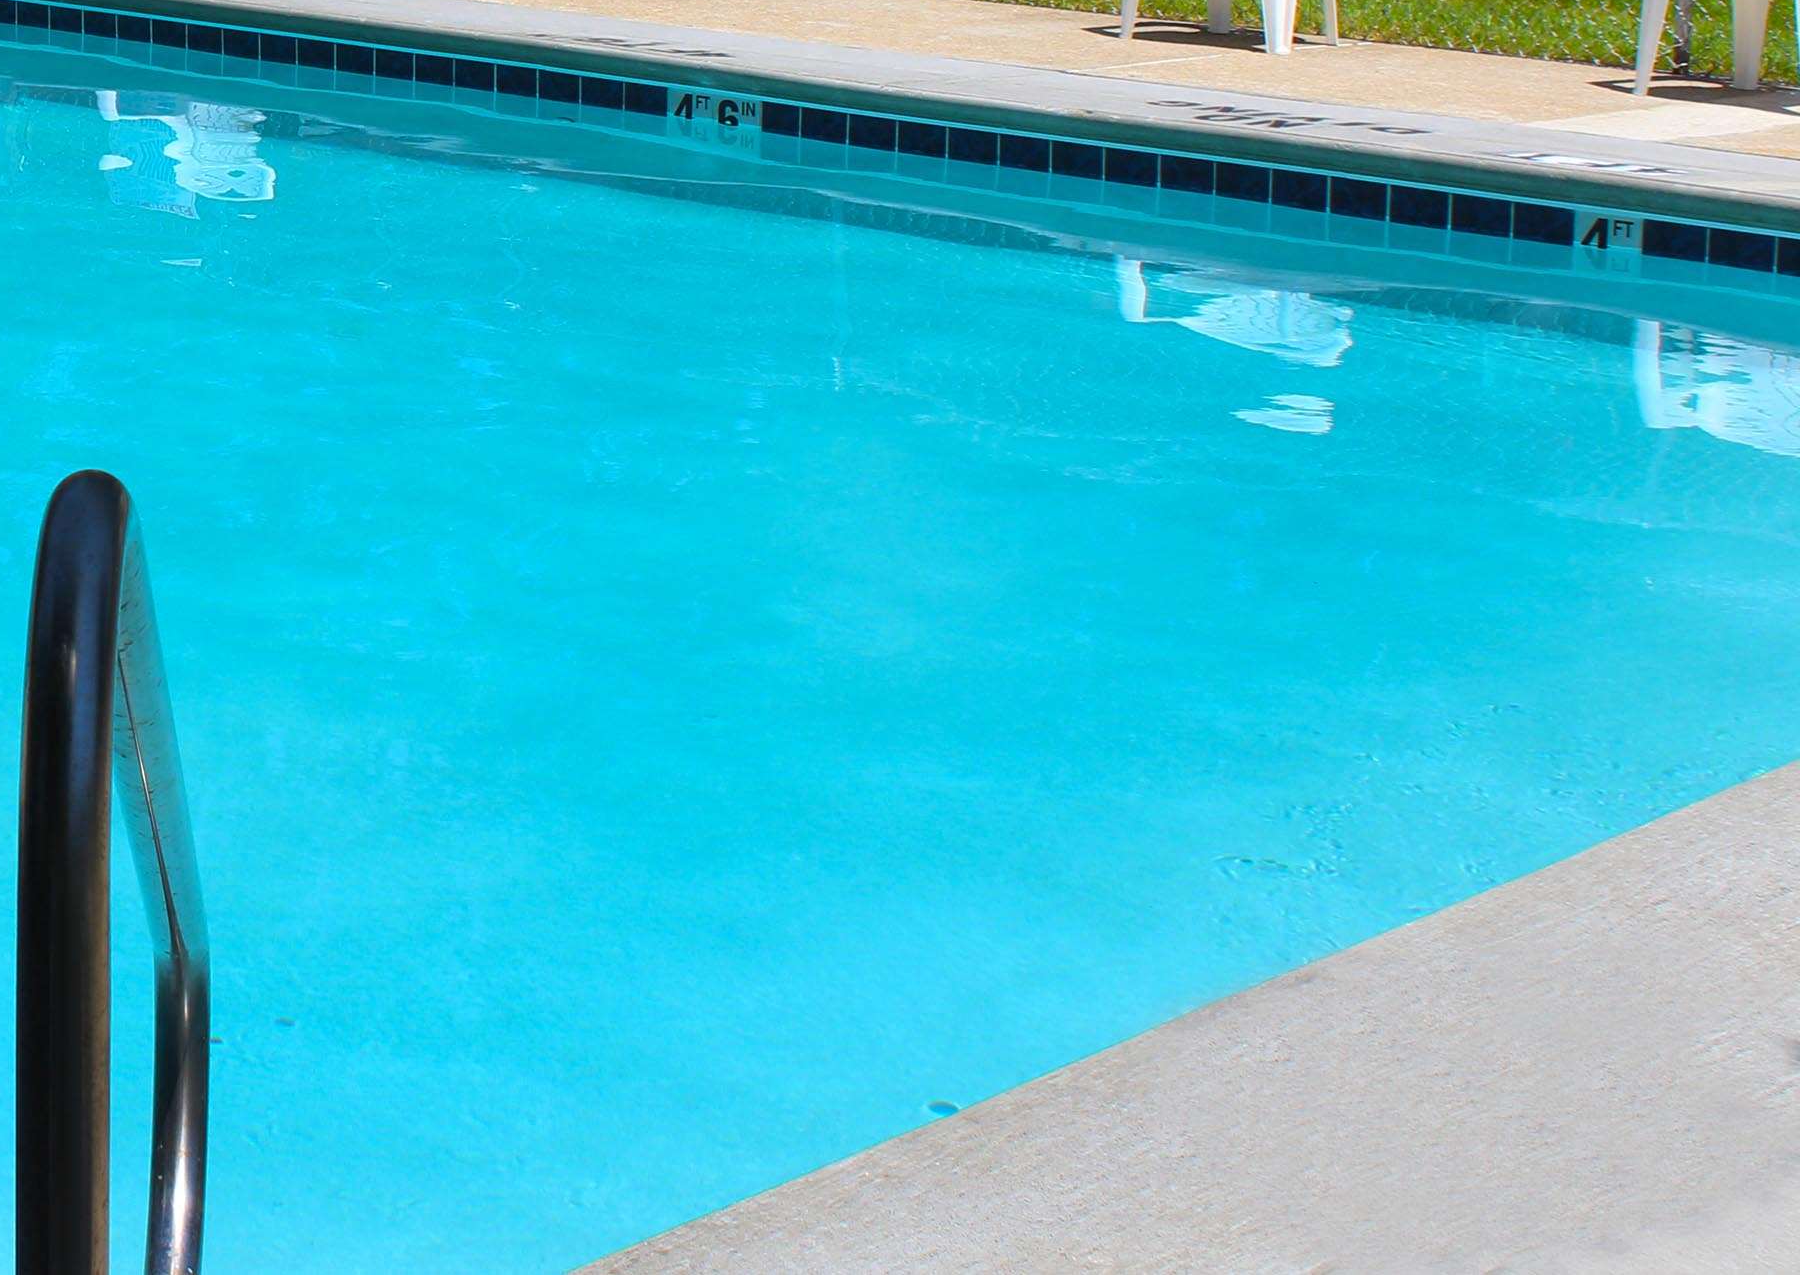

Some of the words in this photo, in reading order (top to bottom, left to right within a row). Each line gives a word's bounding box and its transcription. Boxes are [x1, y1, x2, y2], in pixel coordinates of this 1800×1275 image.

[673, 93, 694, 120] 4
[695, 95, 711, 111] FT
[717, 99, 741, 127] 6
[741, 101, 756, 117] IN
[1580, 217, 1609, 250] 4
[1613, 220, 1635, 238] FT
